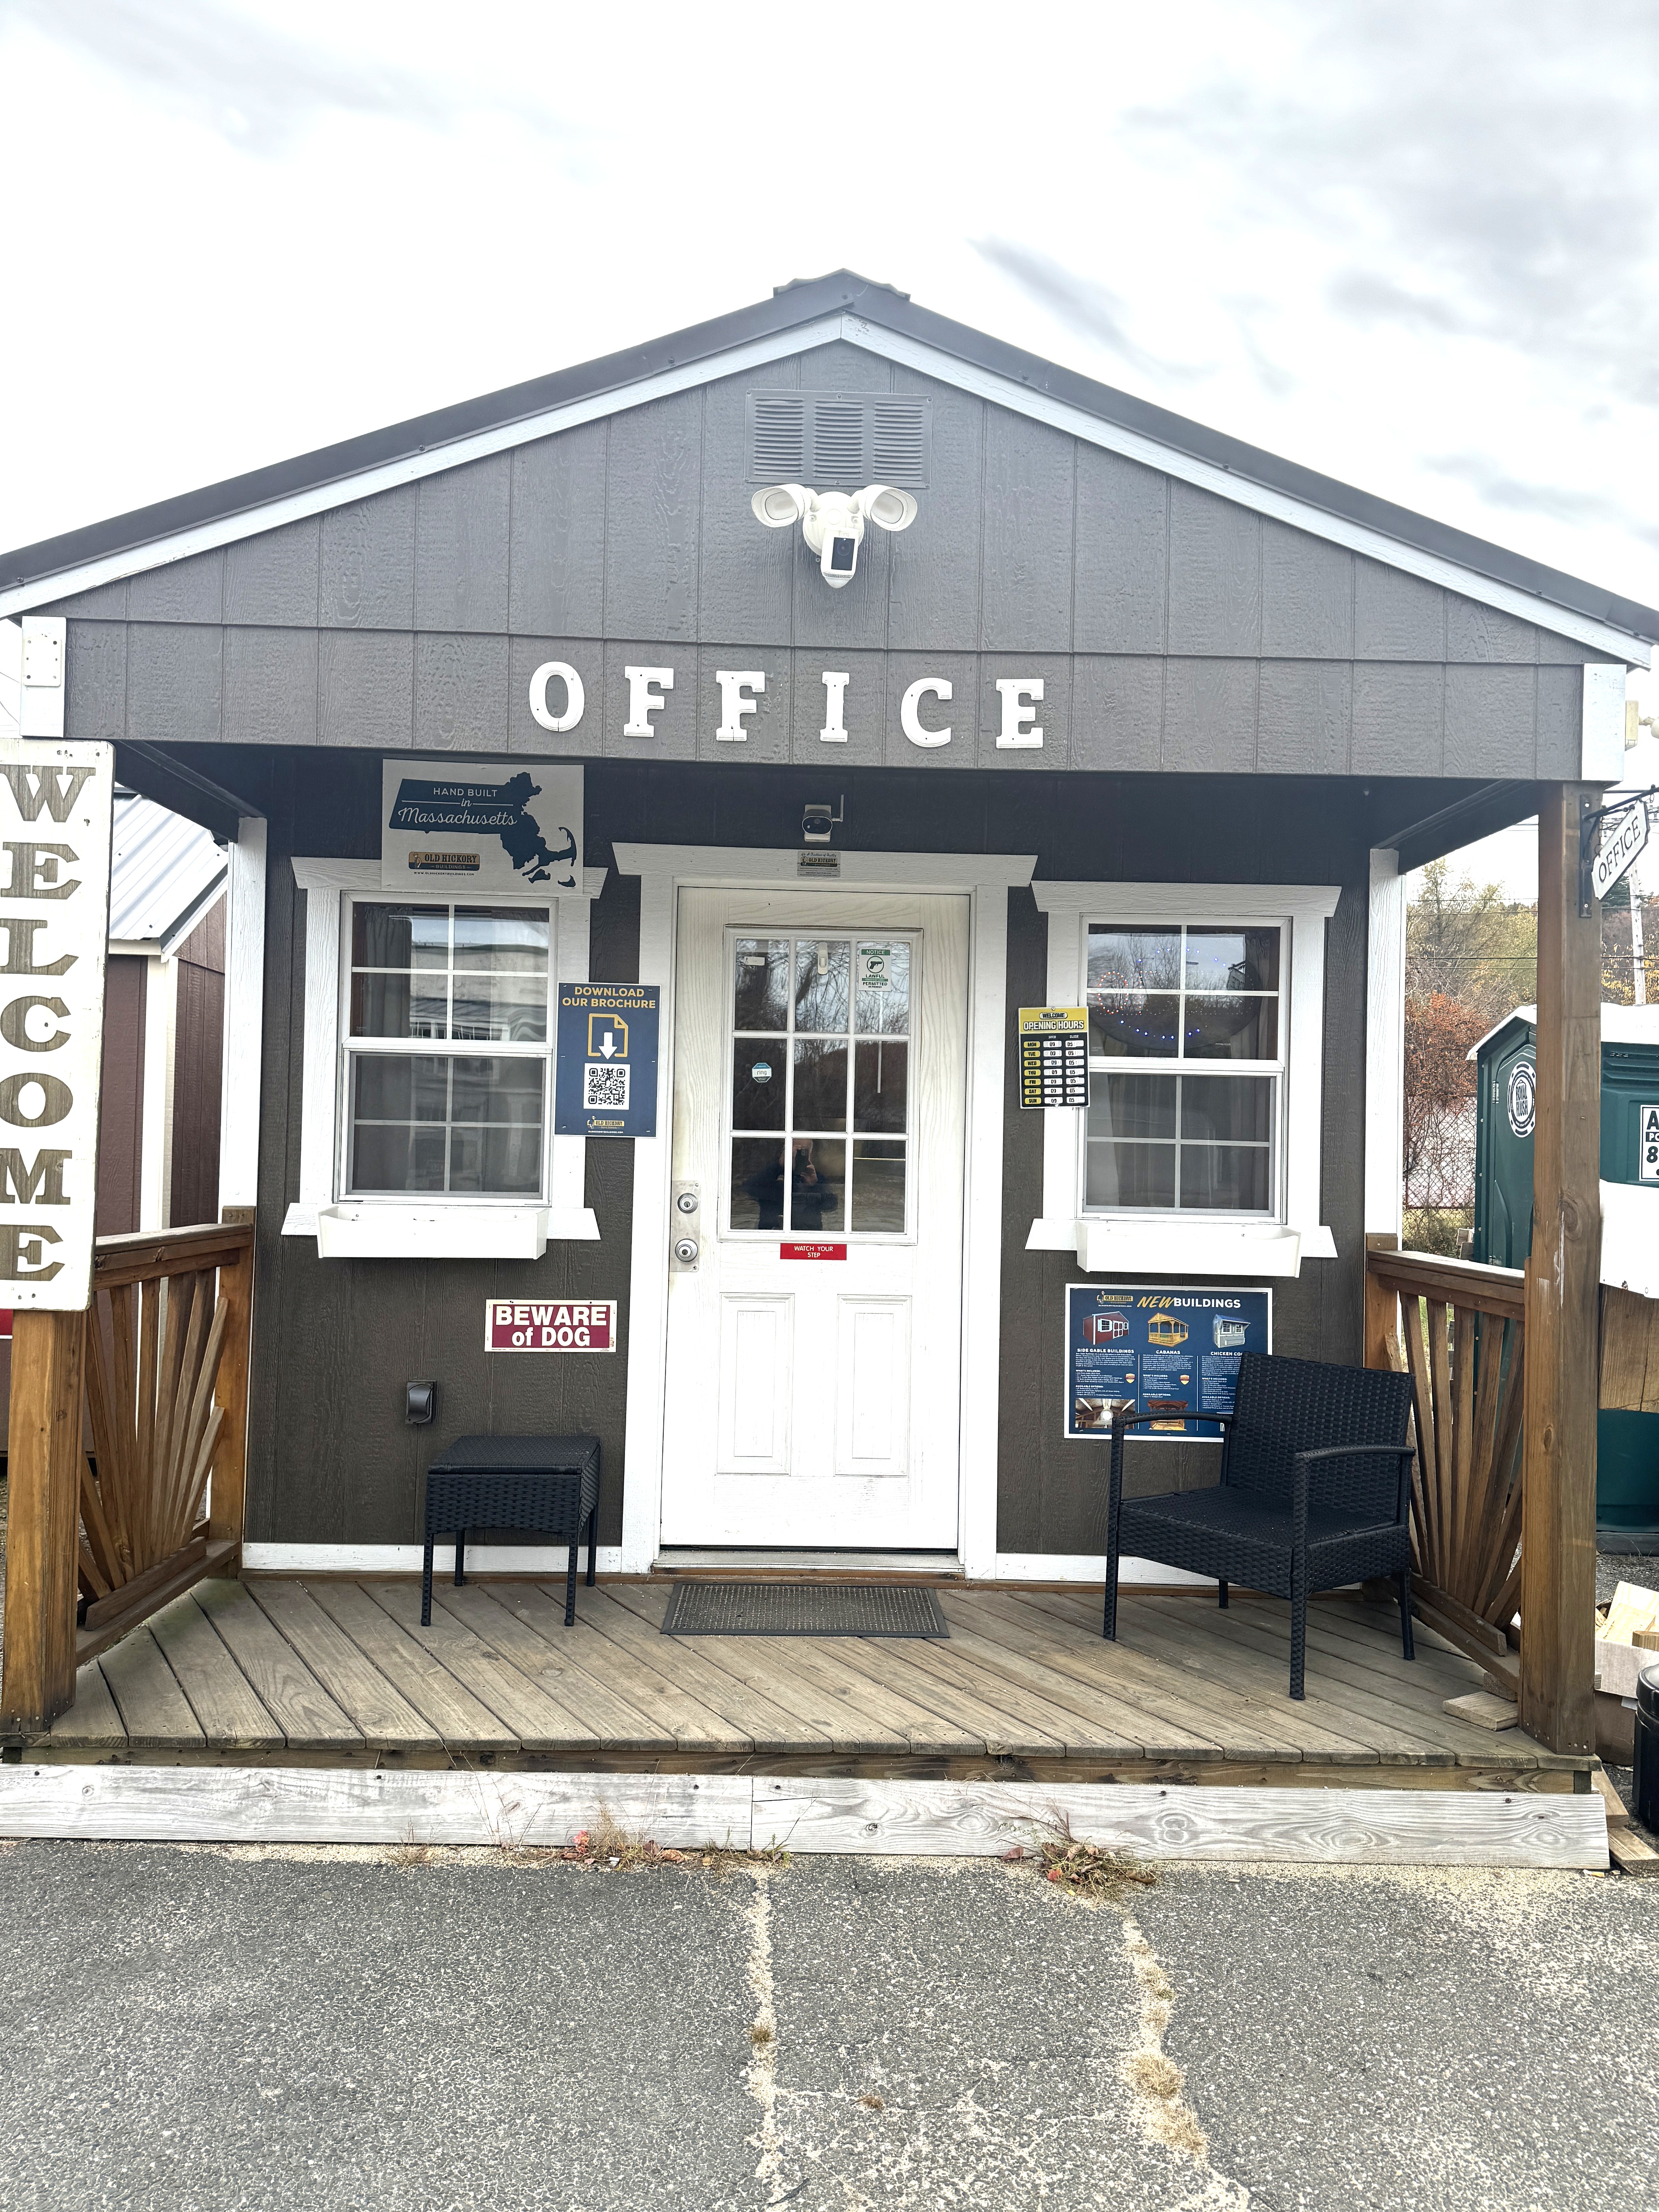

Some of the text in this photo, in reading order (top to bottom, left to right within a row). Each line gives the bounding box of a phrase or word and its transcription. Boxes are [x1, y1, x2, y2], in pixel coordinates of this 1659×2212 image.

[529, 661, 1044, 749] OFFICE
[433, 787, 498, 797] HAND BUILT
[461, 798, 472, 807] in
[398, 807, 517, 825] Massachusetts
[1599, 815, 1641, 883] OFFICE
[424, 854, 477, 863] OLD HICKORY
[574, 986, 645, 997] DOWNLOAD
[562, 997, 656, 1009] OUR BROCHURE
[0, 764, 96, 1281] WELCOME
[1024, 1020, 1084, 1030] OPENING HOURS
[1516, 1084, 1527, 1101] ROYAL
[1137, 1295, 1241, 1309] NEW BUILDINGS
[495, 1305, 607, 1326] BEWARE
[511, 1327, 534, 1346] of
[541, 1326, 591, 1346] DOG
